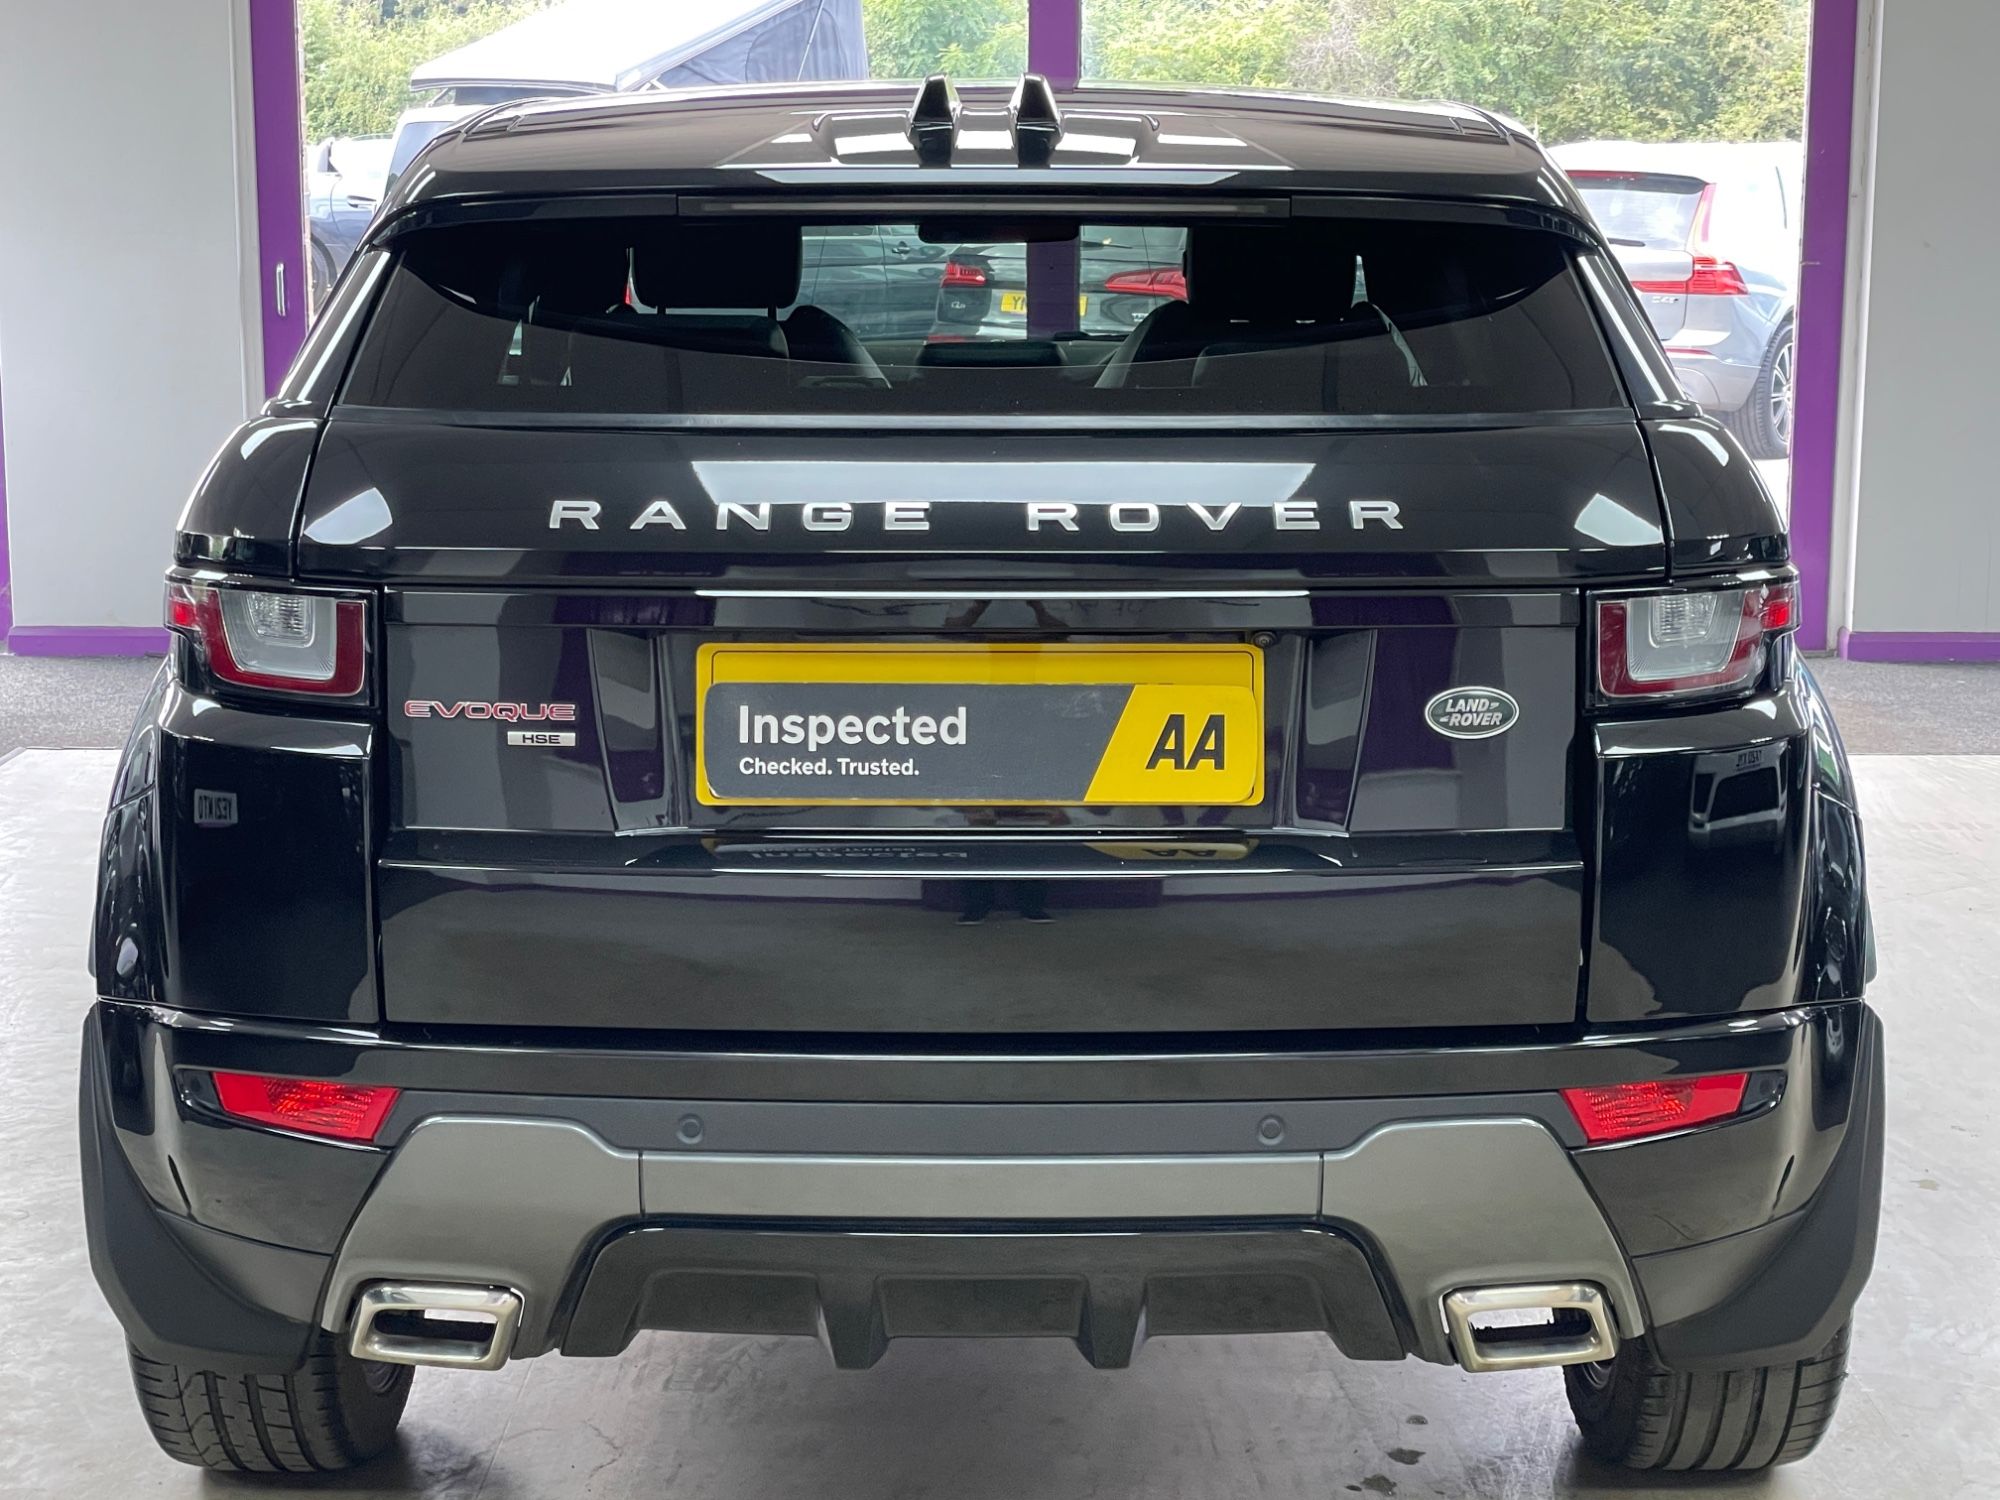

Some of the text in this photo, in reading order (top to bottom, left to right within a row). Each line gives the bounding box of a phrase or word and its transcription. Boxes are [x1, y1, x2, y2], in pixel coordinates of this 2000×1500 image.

[549, 500, 1404, 532] RANGE ROVER
[404, 700, 576, 722] EVOQUE
[1445, 699, 1490, 712] LAND
[739, 705, 967, 751] Inspected
[1449, 712, 1503, 726] ROVER
[522, 734, 561, 744] HSE
[1145, 713, 1225, 770] AA
[739, 757, 920, 776] Checked. Trusted.
